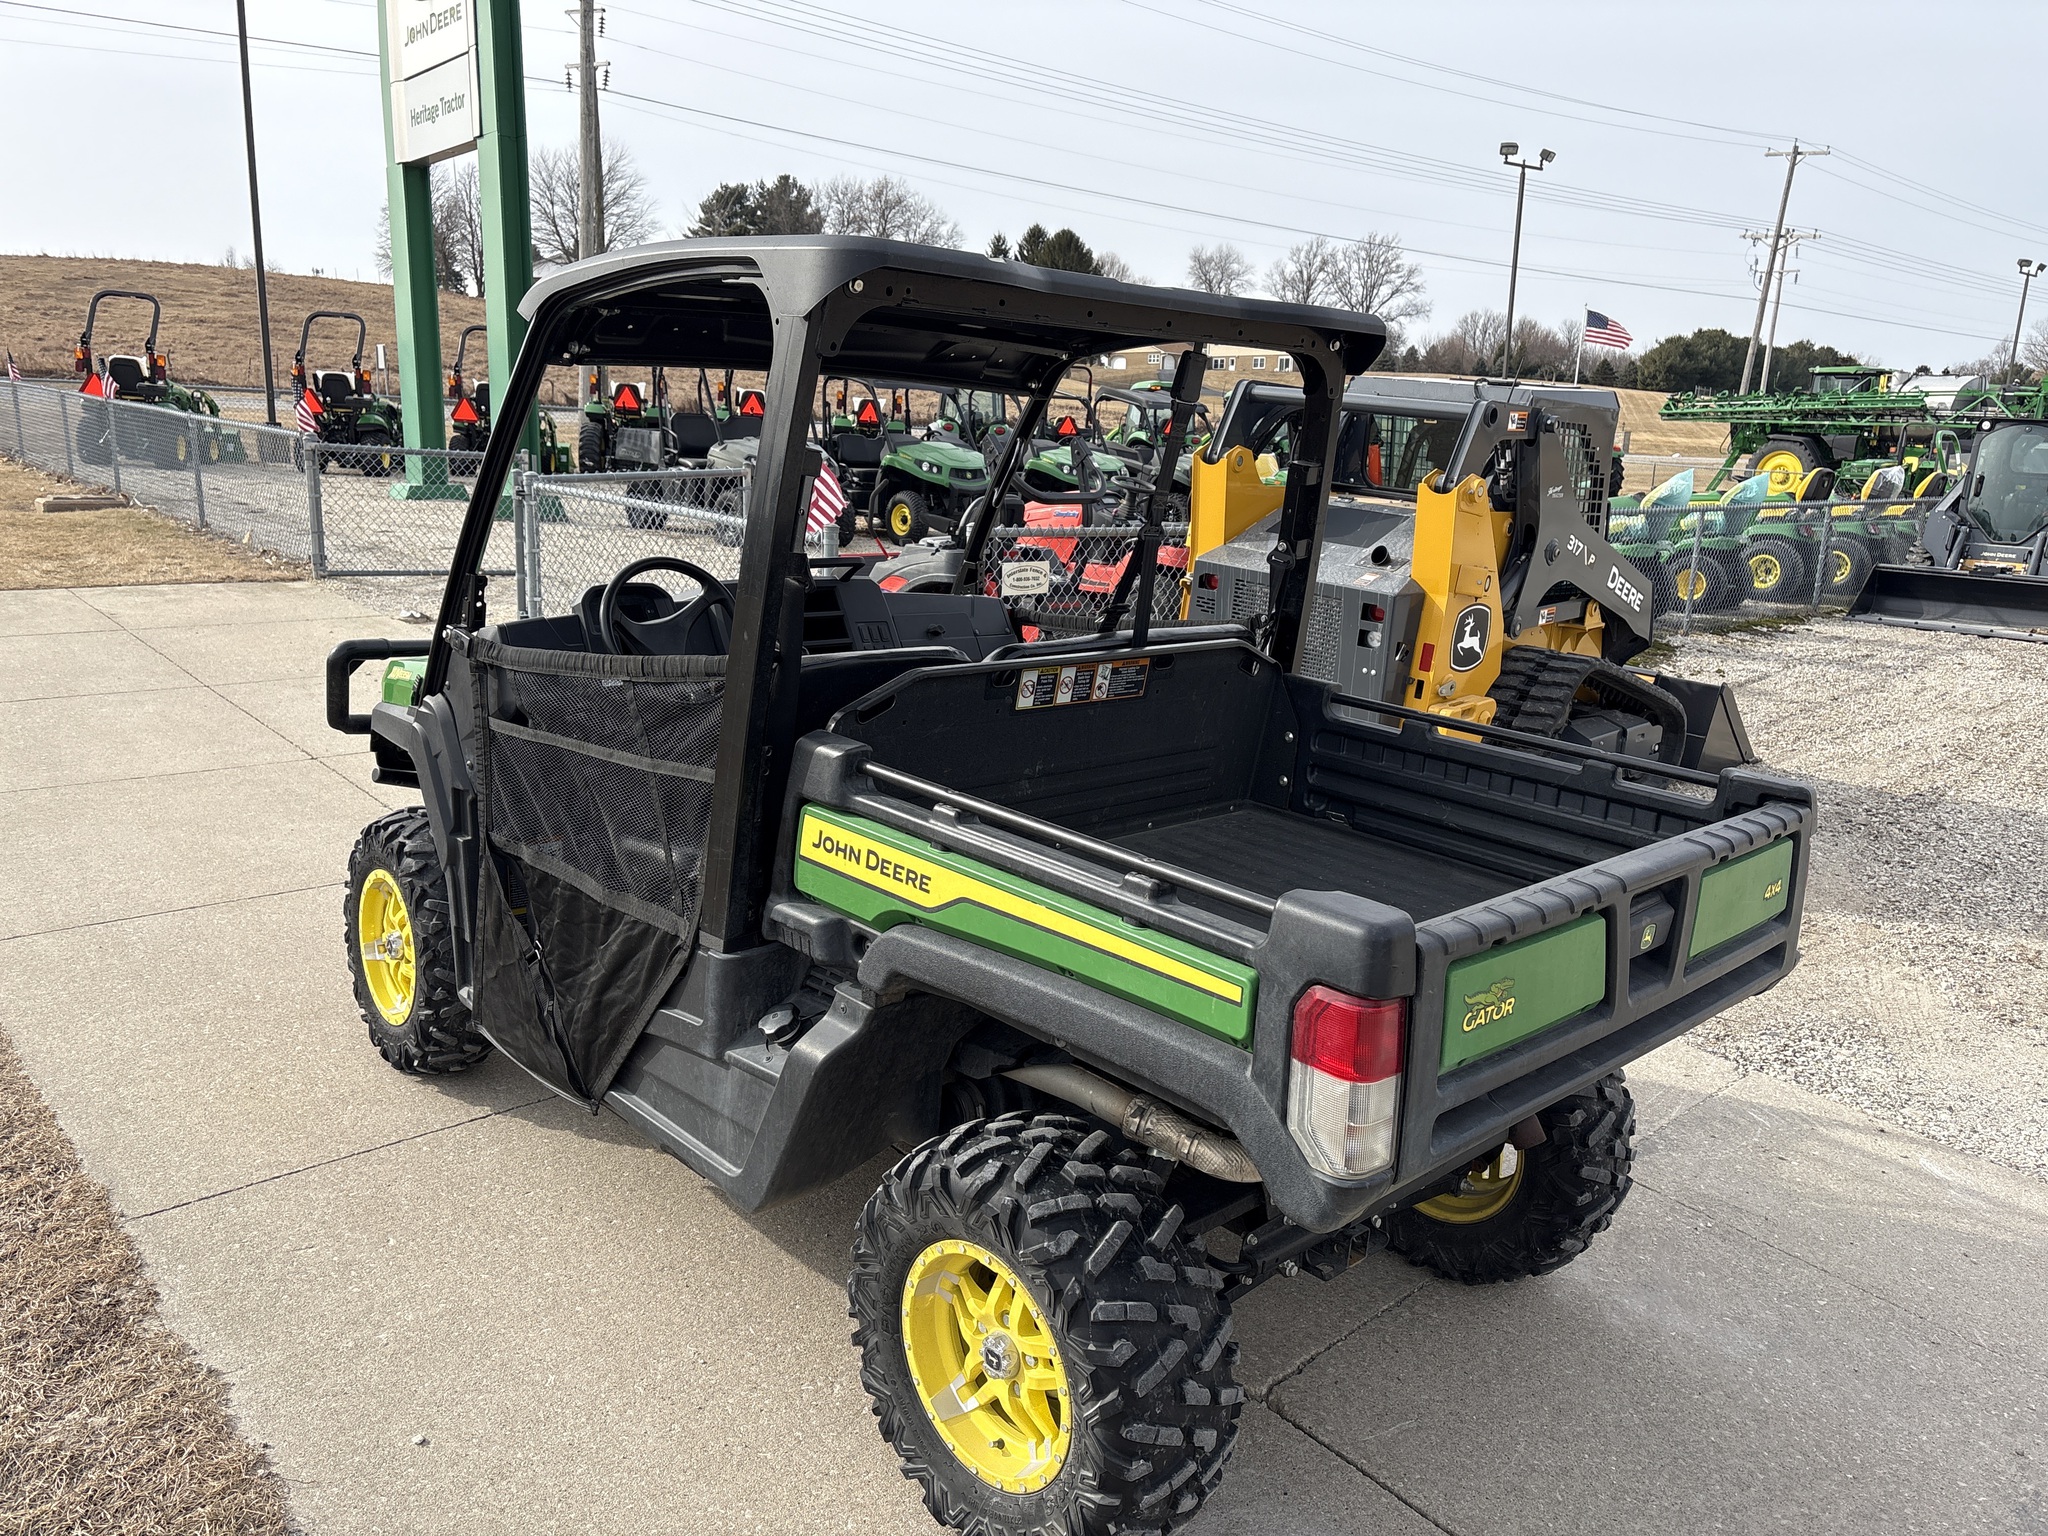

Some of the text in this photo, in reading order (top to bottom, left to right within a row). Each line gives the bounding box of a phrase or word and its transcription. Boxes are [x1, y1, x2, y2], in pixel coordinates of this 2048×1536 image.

[404, 3, 462, 47] JOHN DEERE
[410, 92, 465, 127] Heritage Tractor
[1606, 564, 1644, 612] DEERE
[812, 830, 932, 894] JOHN DEERE
[1462, 997, 1516, 1032] GATOR
